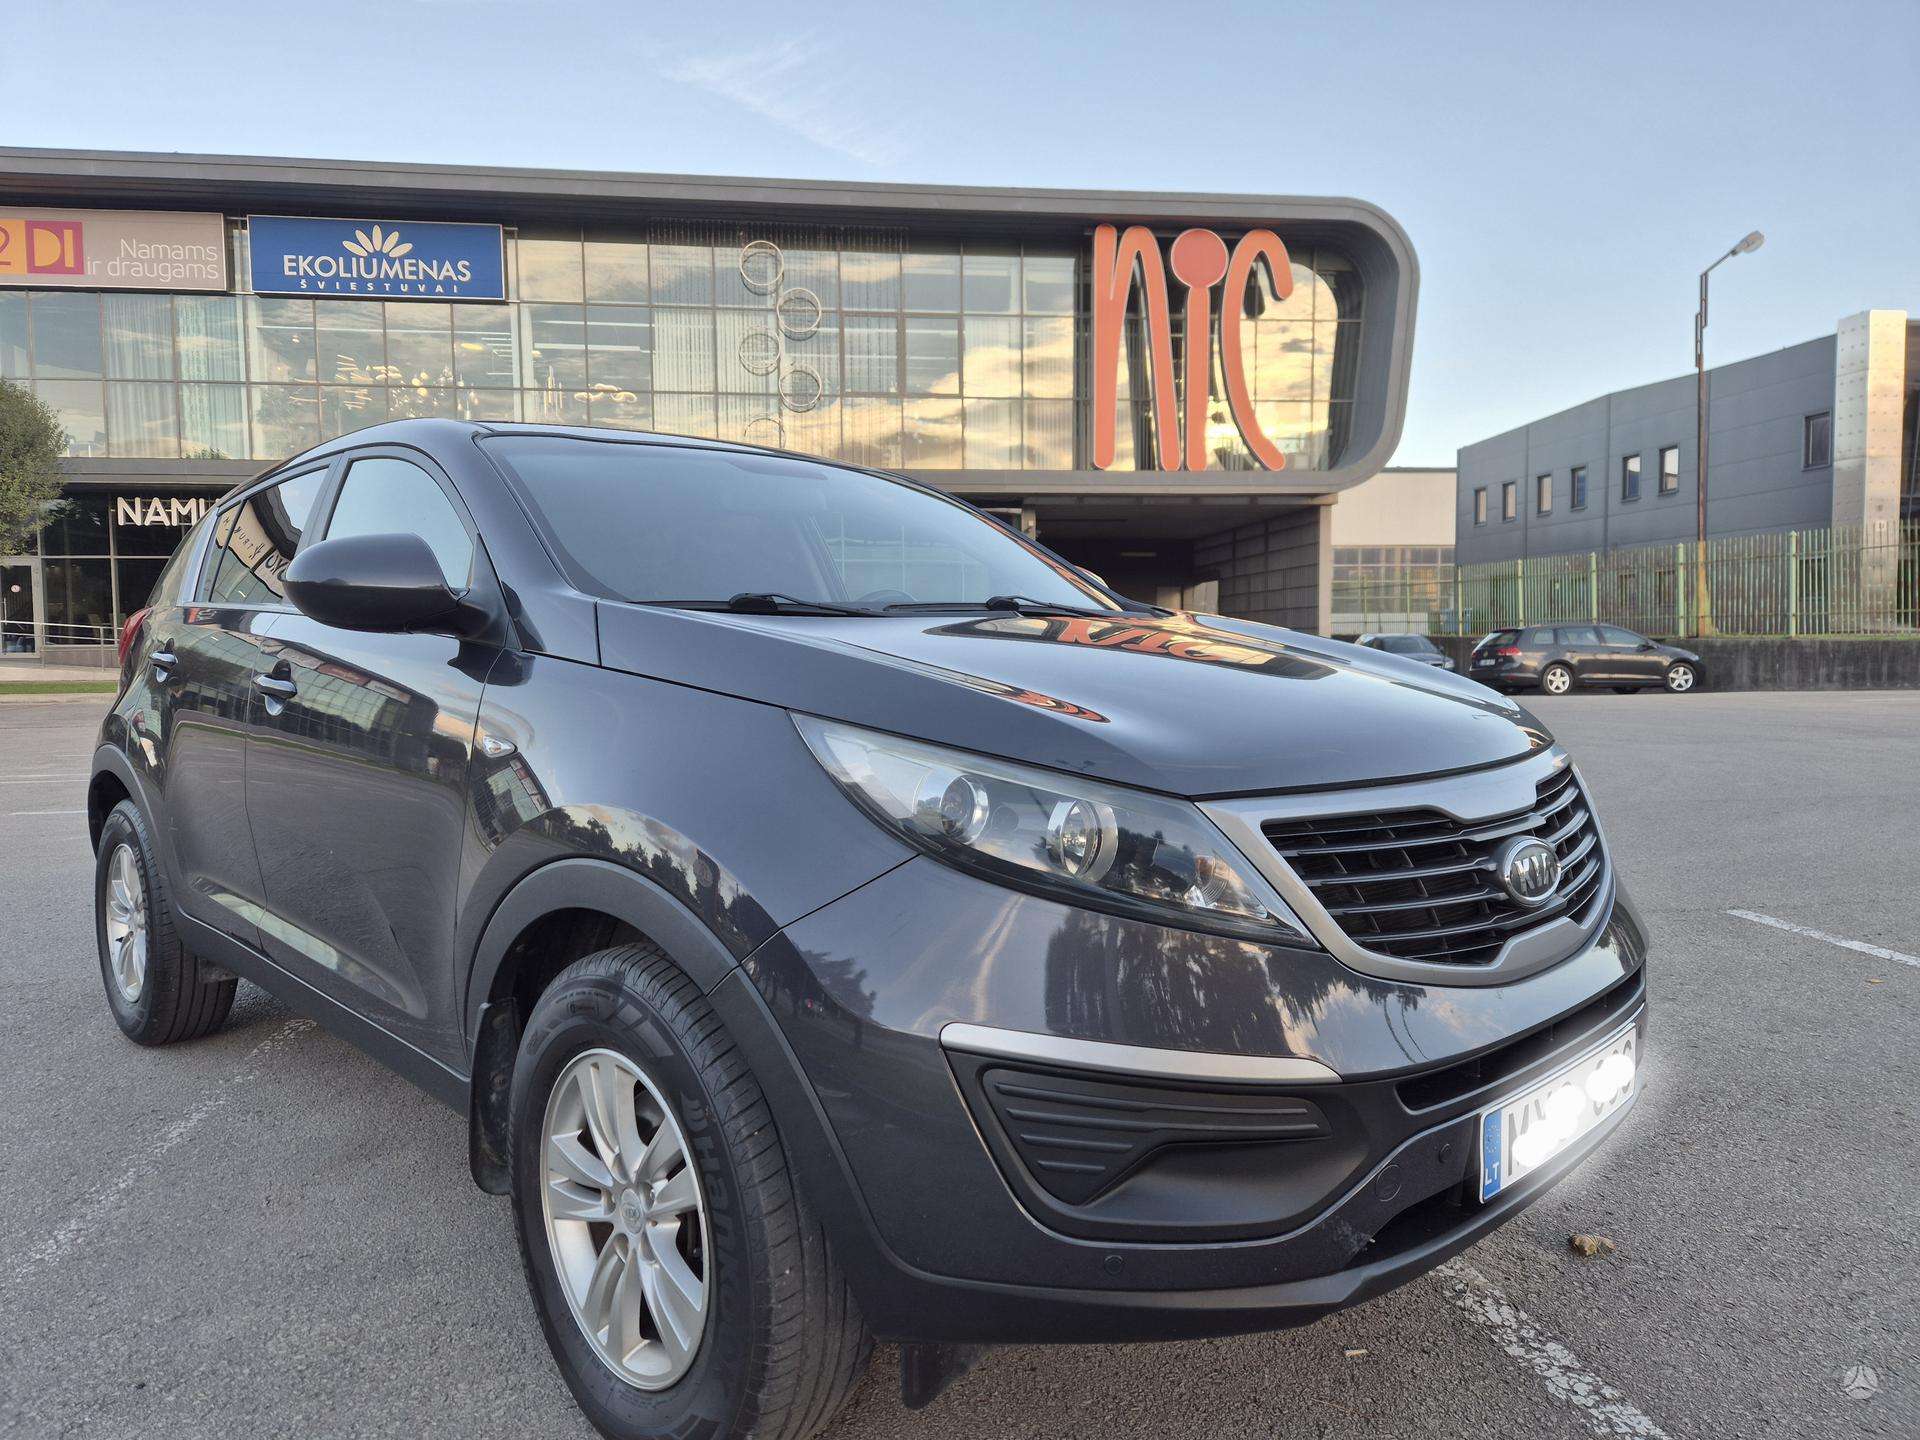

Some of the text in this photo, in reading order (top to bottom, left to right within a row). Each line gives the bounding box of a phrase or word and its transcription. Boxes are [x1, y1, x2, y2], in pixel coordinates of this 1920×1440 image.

[120, 238, 218, 260] Namams
[87, 256, 219, 282] ir draugams
[283, 254, 471, 282] EKOLIUMENAS
[300, 278, 458, 294] ŠVIESTUVAI
[1485, 1161, 1500, 1186] LT
